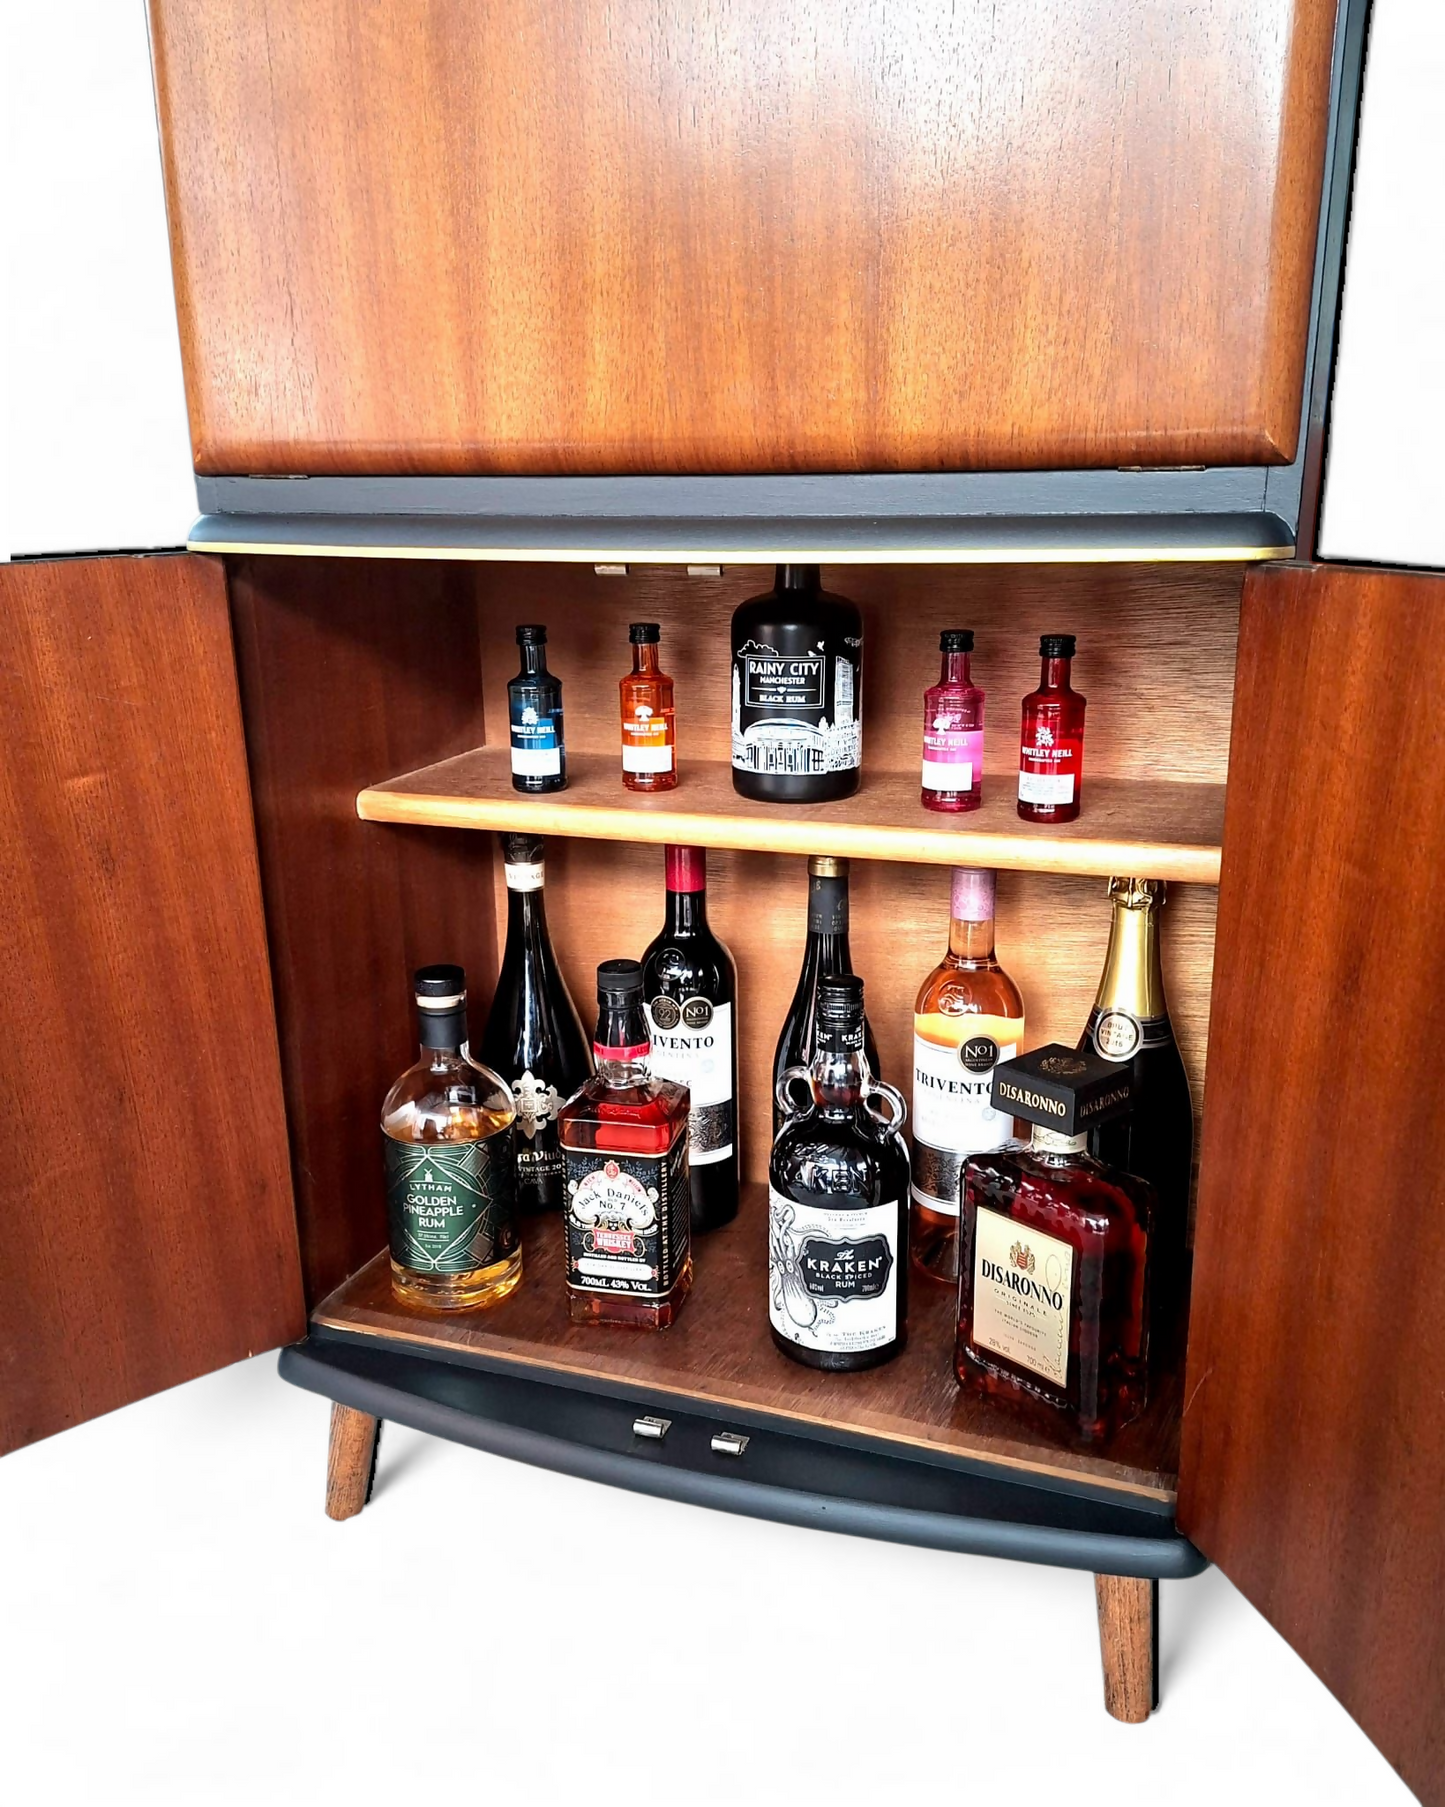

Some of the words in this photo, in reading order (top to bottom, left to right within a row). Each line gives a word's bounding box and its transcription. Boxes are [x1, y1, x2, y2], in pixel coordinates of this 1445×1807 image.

[749, 661, 785, 676] RAINY
[789, 662, 820, 676] CITY
[759, 676, 806, 685] MANCHESTER
[759, 694, 784, 703] BLACK
[786, 695, 806, 703] RUM
[653, 1034, 714, 1049] IVENTO
[999, 1081, 1067, 1117] DISARONNO
[1080, 1086, 1130, 1118] DISARONNO
[409, 1184, 452, 1192] LYTHAM
[660, 1161, 668, 1213] DISTILLERY
[406, 1193, 457, 1206] GOLDEN
[578, 1191, 602, 1209] Jack
[607, 1187, 649, 1217] Daniel's
[402, 1202, 464, 1217] PINEAPPLE
[418, 1217, 446, 1229] RUM
[661, 1213, 669, 1233] THE
[597, 1239, 632, 1249] WHISKEY
[662, 1234, 669, 1246] AT
[834, 1249, 855, 1261] The
[662, 1247, 670, 1287] BOTTLED
[807, 1257, 880, 1273] KRAKEN
[815, 1272, 841, 1280] BLACK
[845, 1272, 873, 1281] SPICED
[610, 1280, 630, 1289] 43%
[835, 1281, 856, 1289] RUM
[981, 1258, 1063, 1311] DISARONNO
[994, 1288, 1048, 1317] ORIGINALE
